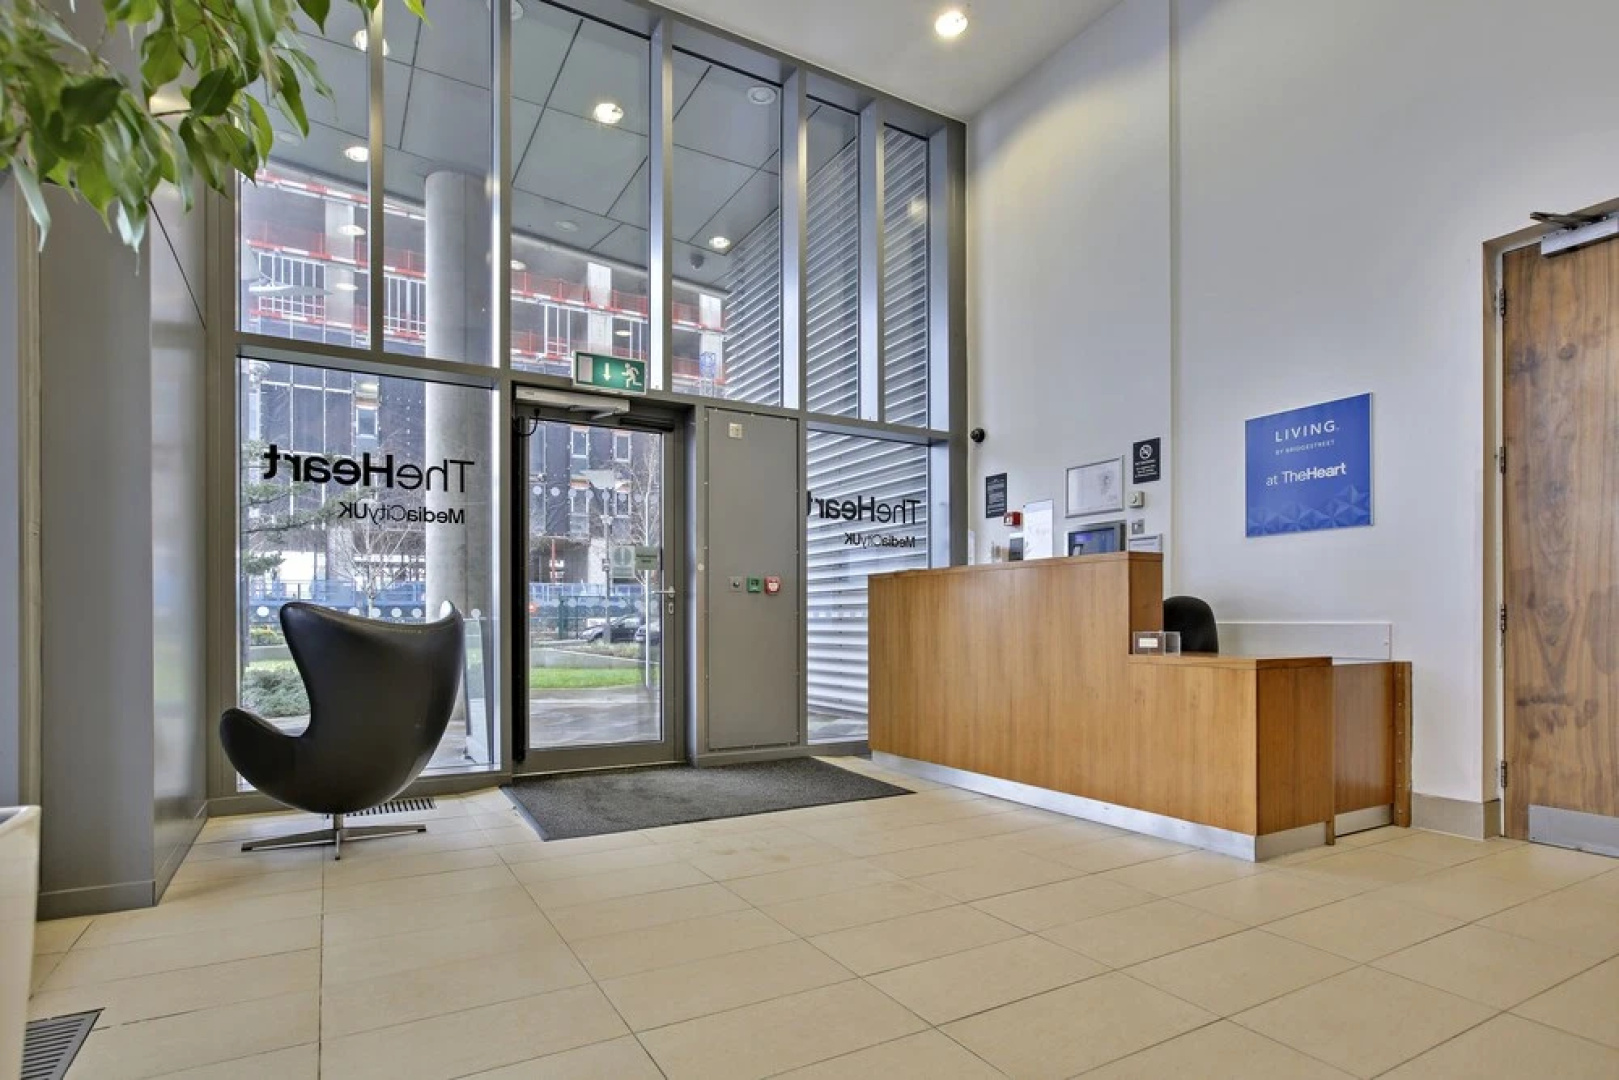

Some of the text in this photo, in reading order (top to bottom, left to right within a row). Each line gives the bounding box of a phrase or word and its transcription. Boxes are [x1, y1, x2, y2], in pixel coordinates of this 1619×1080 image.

[1275, 420, 1335, 443] LIVING
[1266, 462, 1347, 486] at TheHeart
